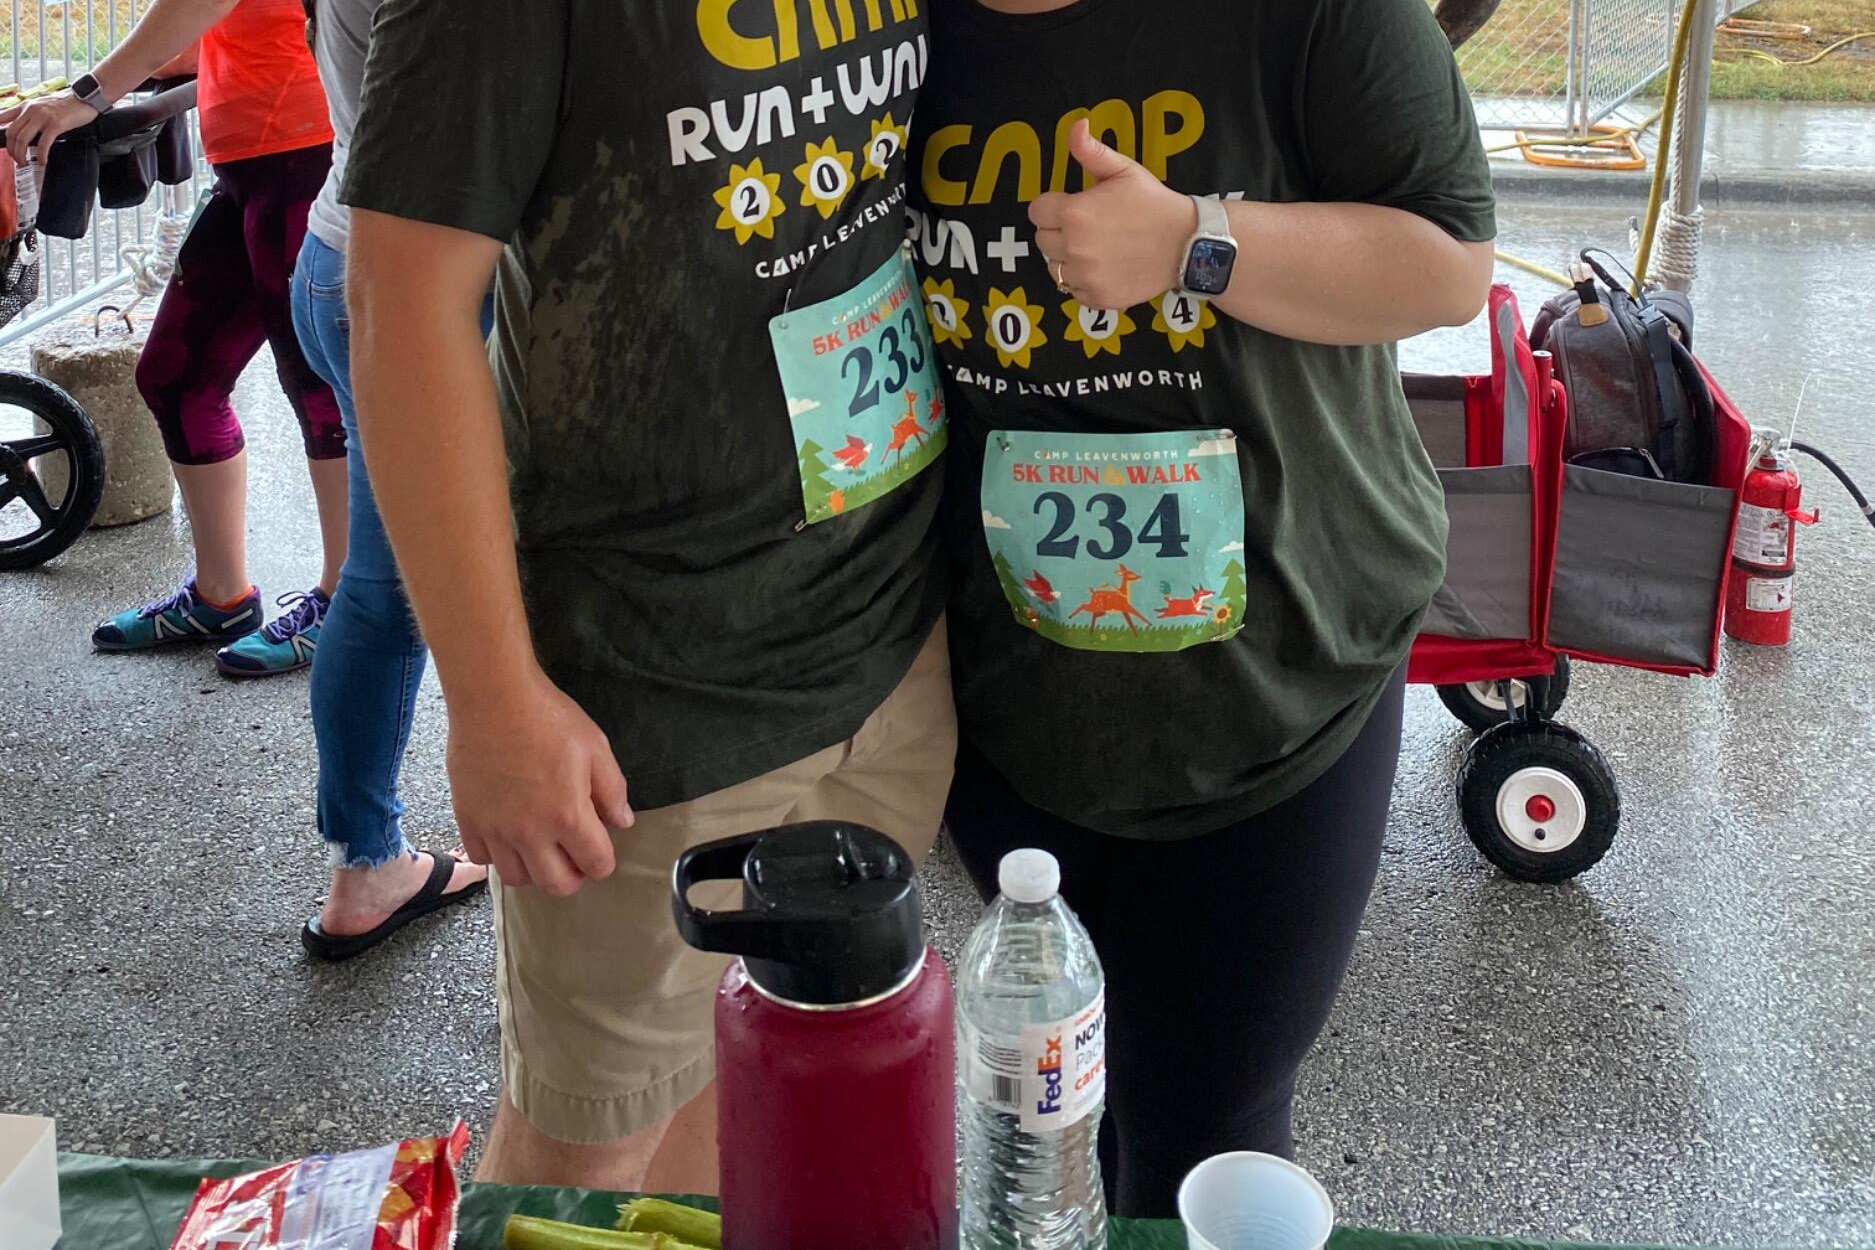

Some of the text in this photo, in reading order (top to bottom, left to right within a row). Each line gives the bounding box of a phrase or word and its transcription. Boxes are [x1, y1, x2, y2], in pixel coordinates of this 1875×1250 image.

[921, 90, 1205, 206] CAMP
[812, 325, 845, 356] 5K
[846, 307, 881, 343] RUN
[841, 307, 925, 418] 233
[947, 364, 1203, 399] AMP LEAVENWORTH
[1013, 463, 1043, 484] 5K
[1049, 464, 1100, 485] RUN
[1126, 462, 1202, 485] WALK
[1034, 450, 1179, 462] CAMP LEAVENWORTH
[1033, 490, 1190, 560] 234
[1037, 1035, 1062, 1115] FedEx
